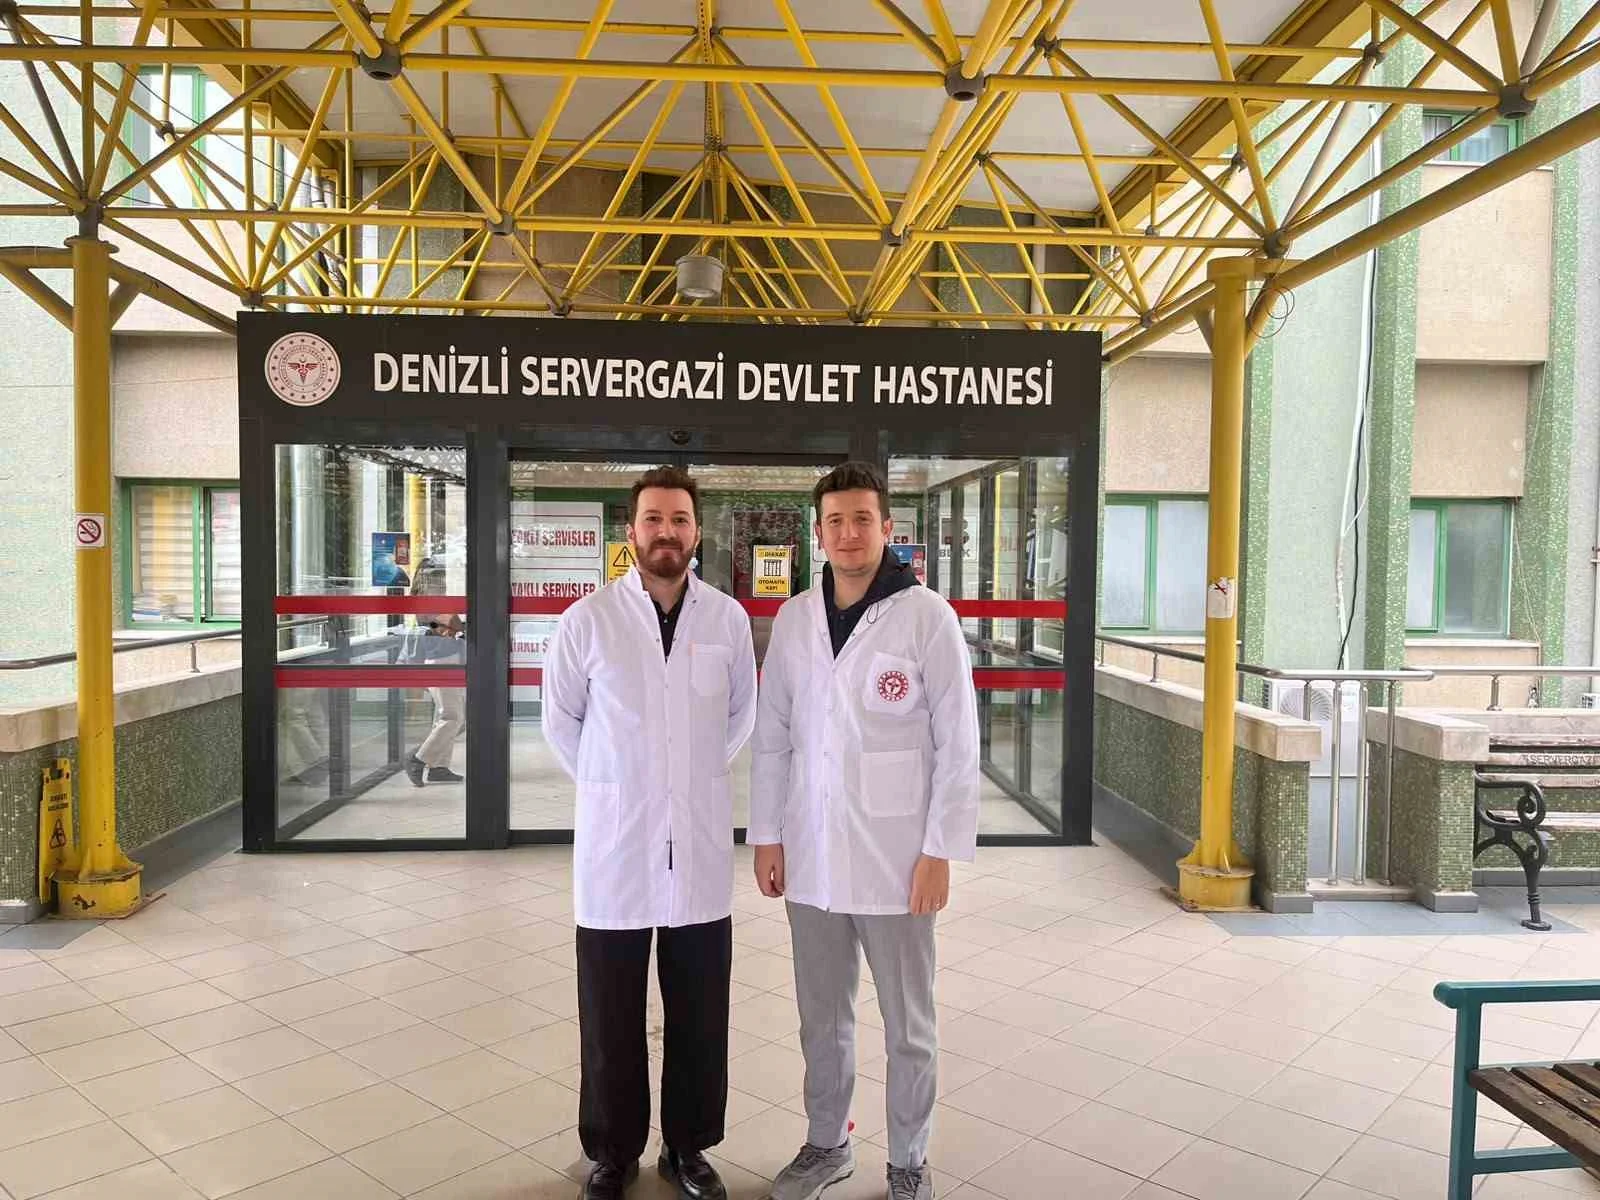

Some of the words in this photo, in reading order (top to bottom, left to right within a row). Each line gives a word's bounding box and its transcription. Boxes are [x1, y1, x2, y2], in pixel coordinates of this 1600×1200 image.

[374, 344, 509, 395] DENİZLİ
[520, 351, 724, 400] SERVERGAZİ
[738, 362, 861, 403] DEVLET
[873, 359, 1053, 406] HASTANESİ
